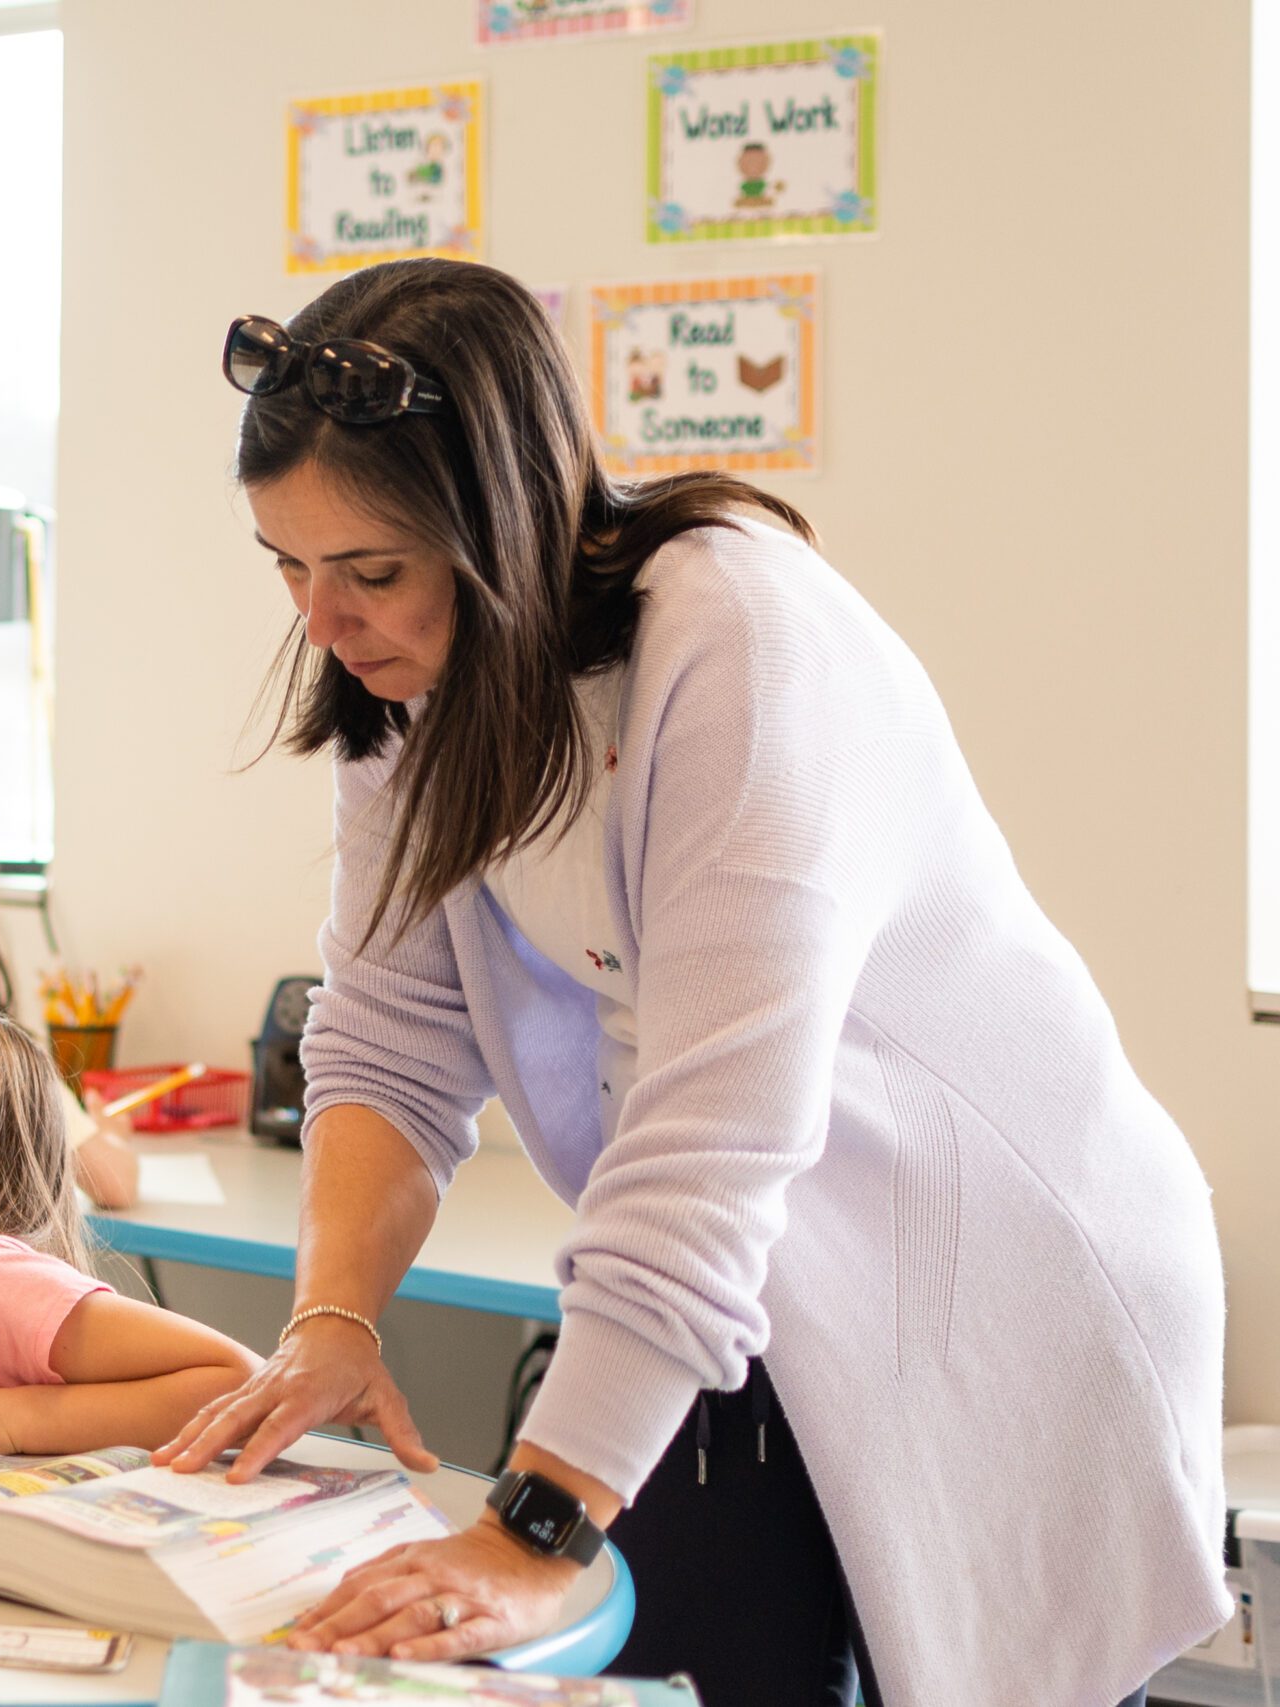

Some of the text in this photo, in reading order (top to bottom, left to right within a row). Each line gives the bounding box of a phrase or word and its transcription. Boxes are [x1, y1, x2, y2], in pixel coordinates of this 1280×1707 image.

[679, 94, 838, 140] Word Work
[345, 121, 416, 157] Listen
[369, 162, 396, 197] to
[334, 206, 428, 247] Reading
[669, 311, 735, 346] Read
[688, 356, 718, 395] to
[640, 408, 763, 444] Someone
